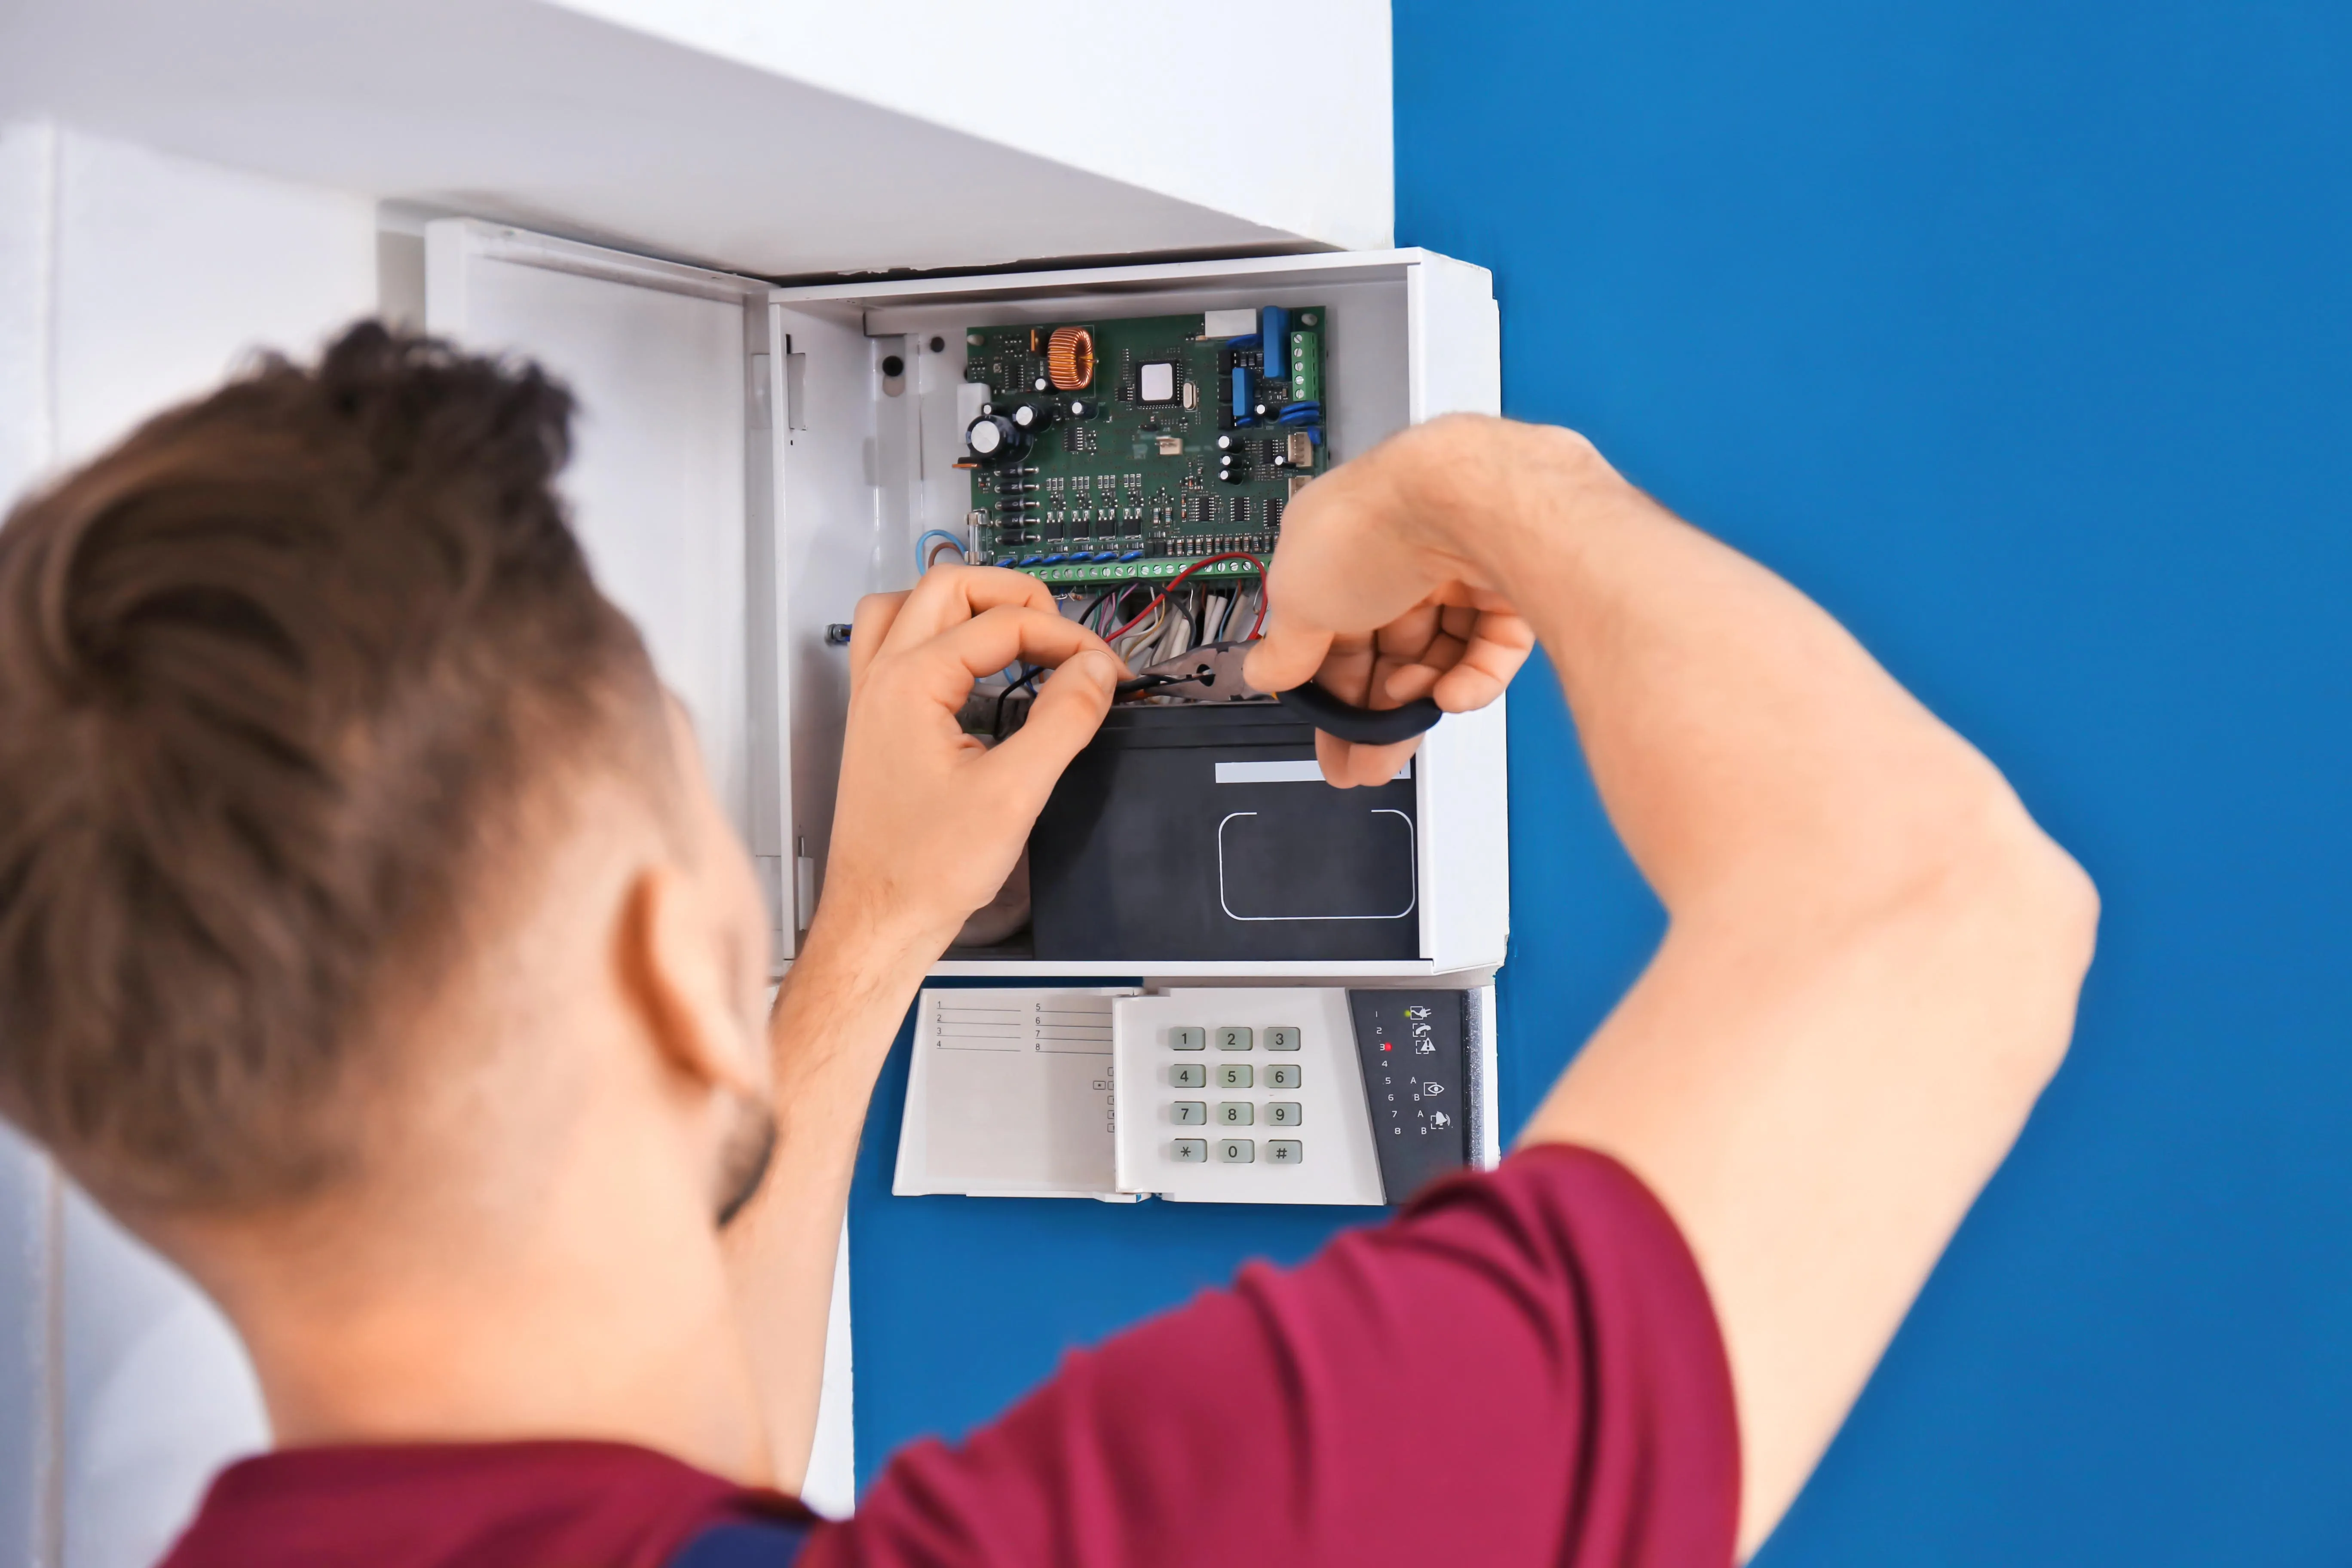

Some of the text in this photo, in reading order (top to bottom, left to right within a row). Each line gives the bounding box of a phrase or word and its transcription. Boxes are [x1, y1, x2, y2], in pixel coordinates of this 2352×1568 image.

[1035, 1017, 1040, 1025] 6
[1182, 1033, 1284, 1045] 1 2 3
[1180, 1070, 1284, 1083] 4 5 6
[1181, 1108, 1284, 1121] 7 8 9
[1228, 1145, 1237, 1158] 0
[1276, 1148, 1287, 1159] #
